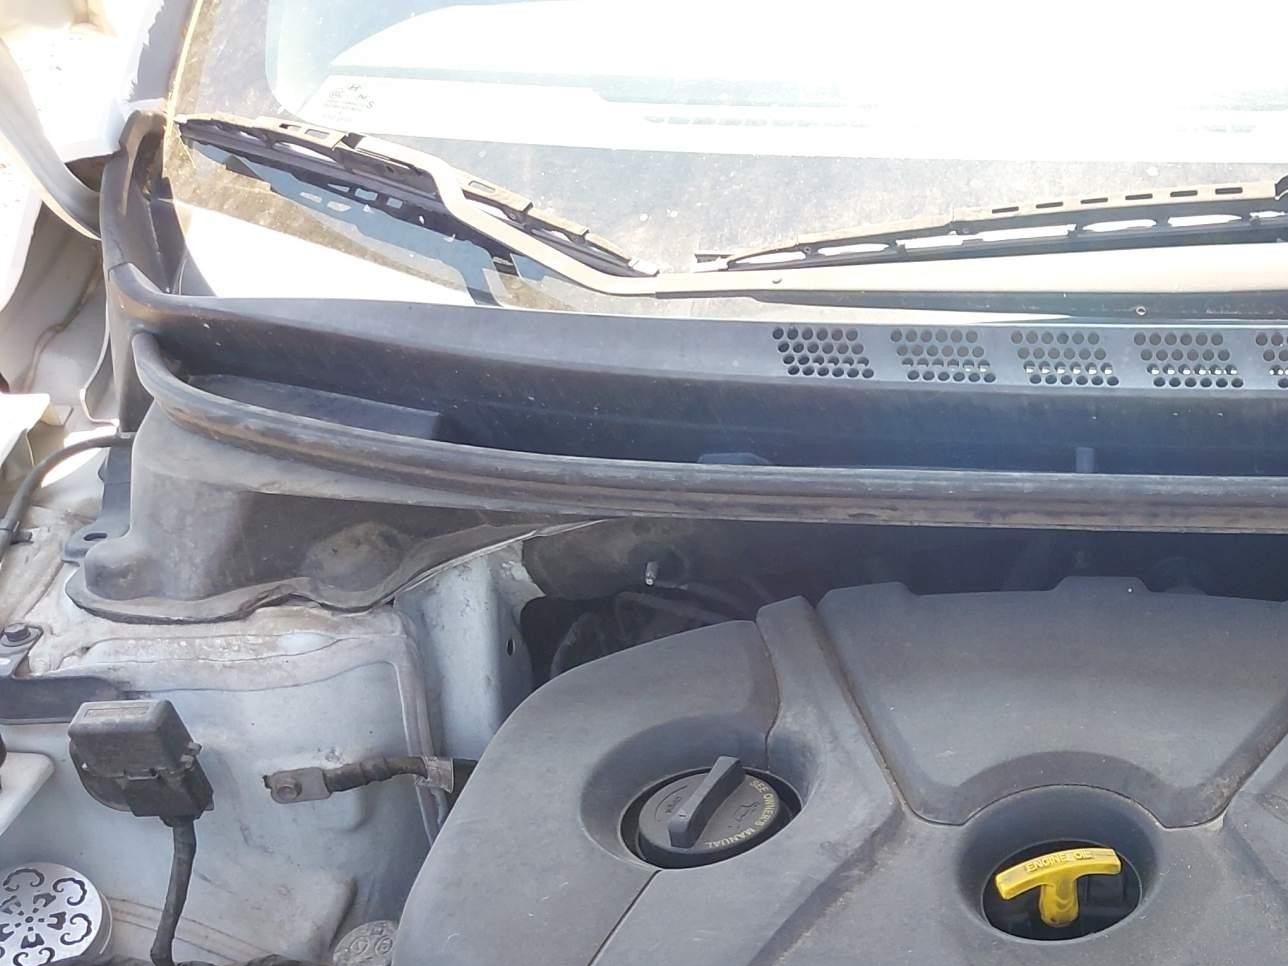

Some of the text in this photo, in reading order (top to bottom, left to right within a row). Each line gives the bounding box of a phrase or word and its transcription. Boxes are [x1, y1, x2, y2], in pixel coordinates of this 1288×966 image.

[750, 779, 769, 793] SEE
[706, 828, 756, 849] MANUAL
[1025, 850, 1094, 873] ENGINE OIL
